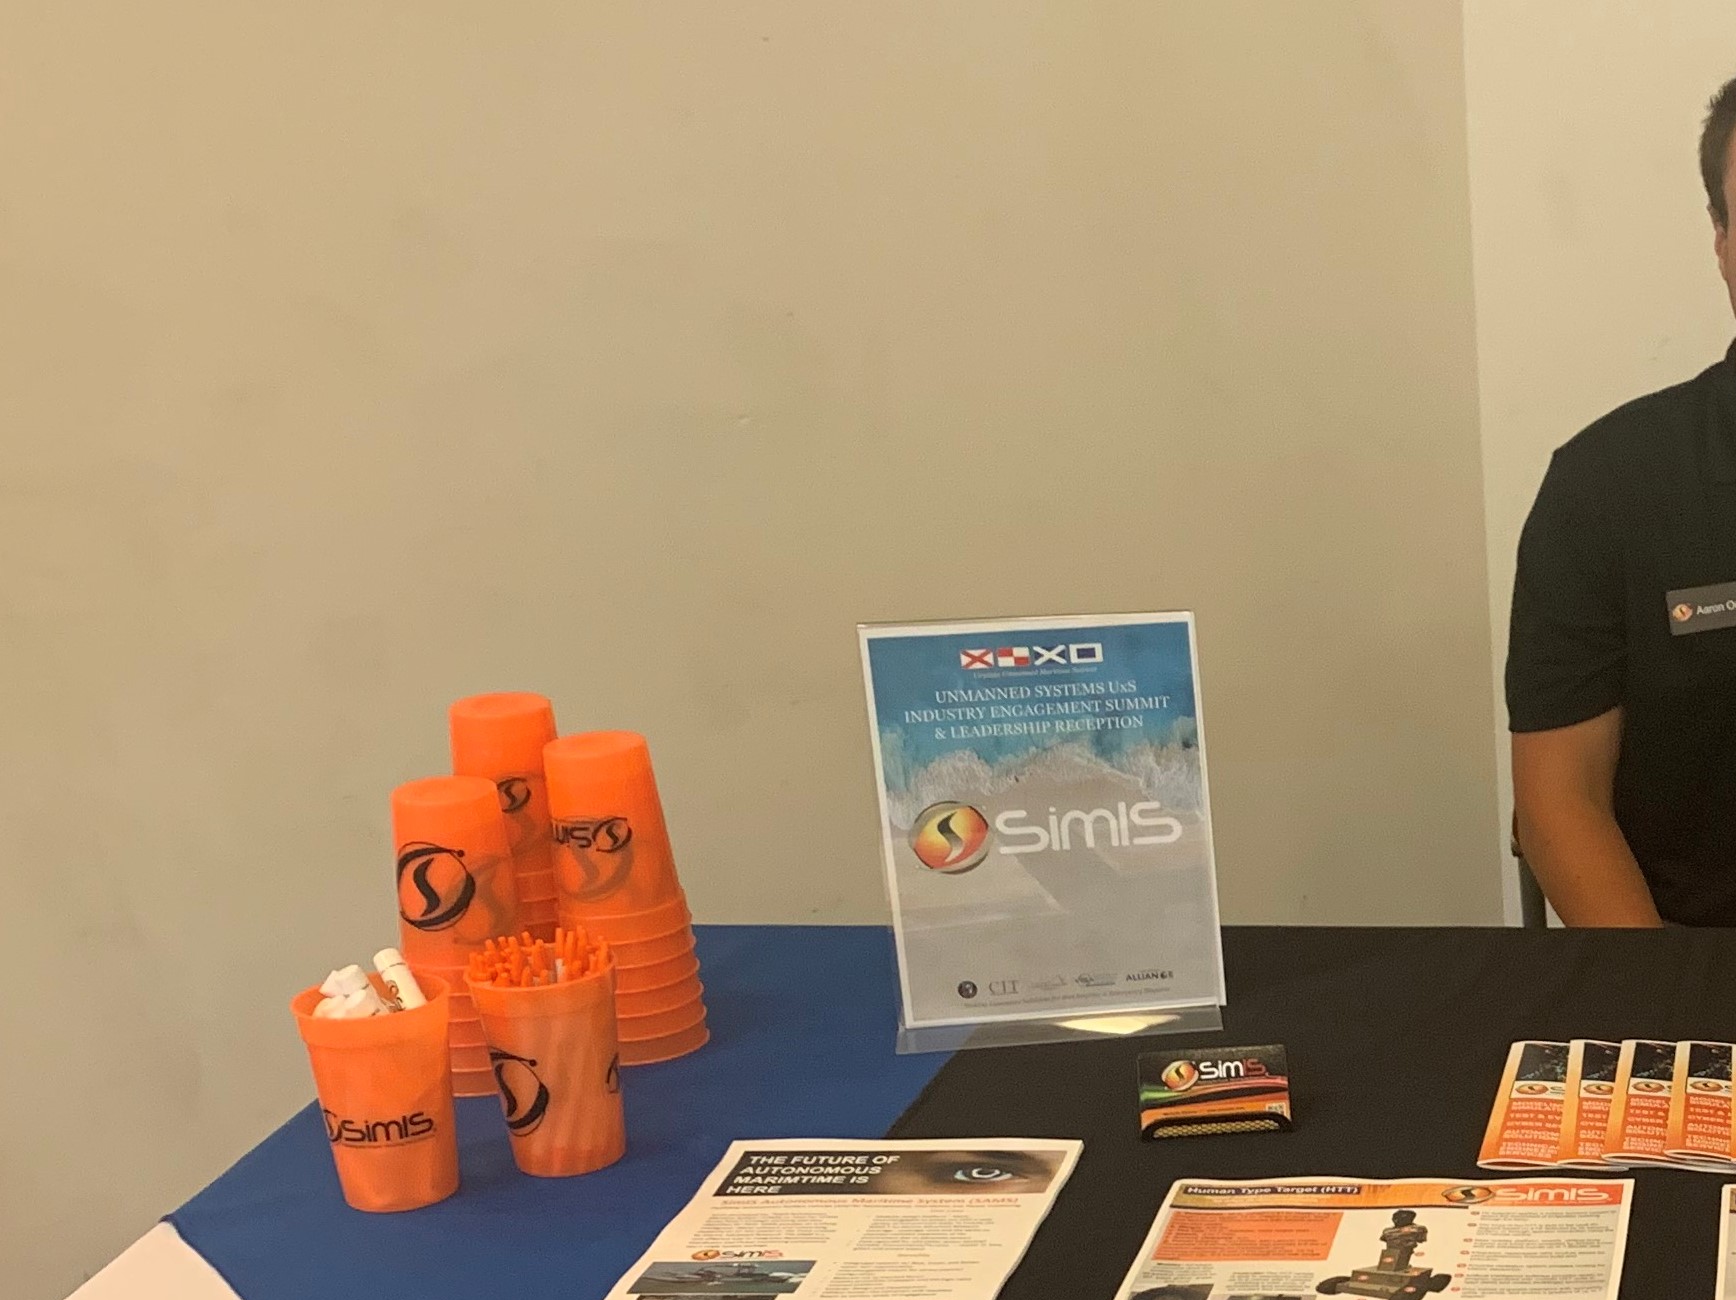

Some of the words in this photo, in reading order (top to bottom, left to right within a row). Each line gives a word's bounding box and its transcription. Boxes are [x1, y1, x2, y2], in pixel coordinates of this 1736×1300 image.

[1696, 603, 1725, 615] Aaron
[936, 686, 1031, 704] UNMANNED
[1034, 682, 1104, 699] SYSTEMS
[1108, 680, 1137, 694] UxS
[904, 705, 986, 723] INDUSTRY
[990, 701, 1101, 719] ENGAGEMENT
[1105, 695, 1170, 711] SUMMIT
[934, 727, 947, 740] &
[951, 720, 1051, 739] LEADERSHIP
[1055, 715, 1144, 733] RECEPTION
[995, 801, 1182, 854] SimIS
[341, 1111, 434, 1142] SimIS
[750, 1155, 788, 1165] THE
[790, 1155, 869, 1165] FUTURE
[872, 1155, 900, 1165] OF
[739, 1166, 882, 1175] AUTONOMOUS
[733, 1176, 846, 1184] MARIMTIME
[849, 1175, 870, 1184] IS
[725, 1185, 782, 1194] HERE
[1187, 1186, 1236, 1194] Human
[1240, 1186, 1272, 1195] Type
[1276, 1186, 1317, 1195] Target
[1320, 1186, 1359, 1194] (HTT)
